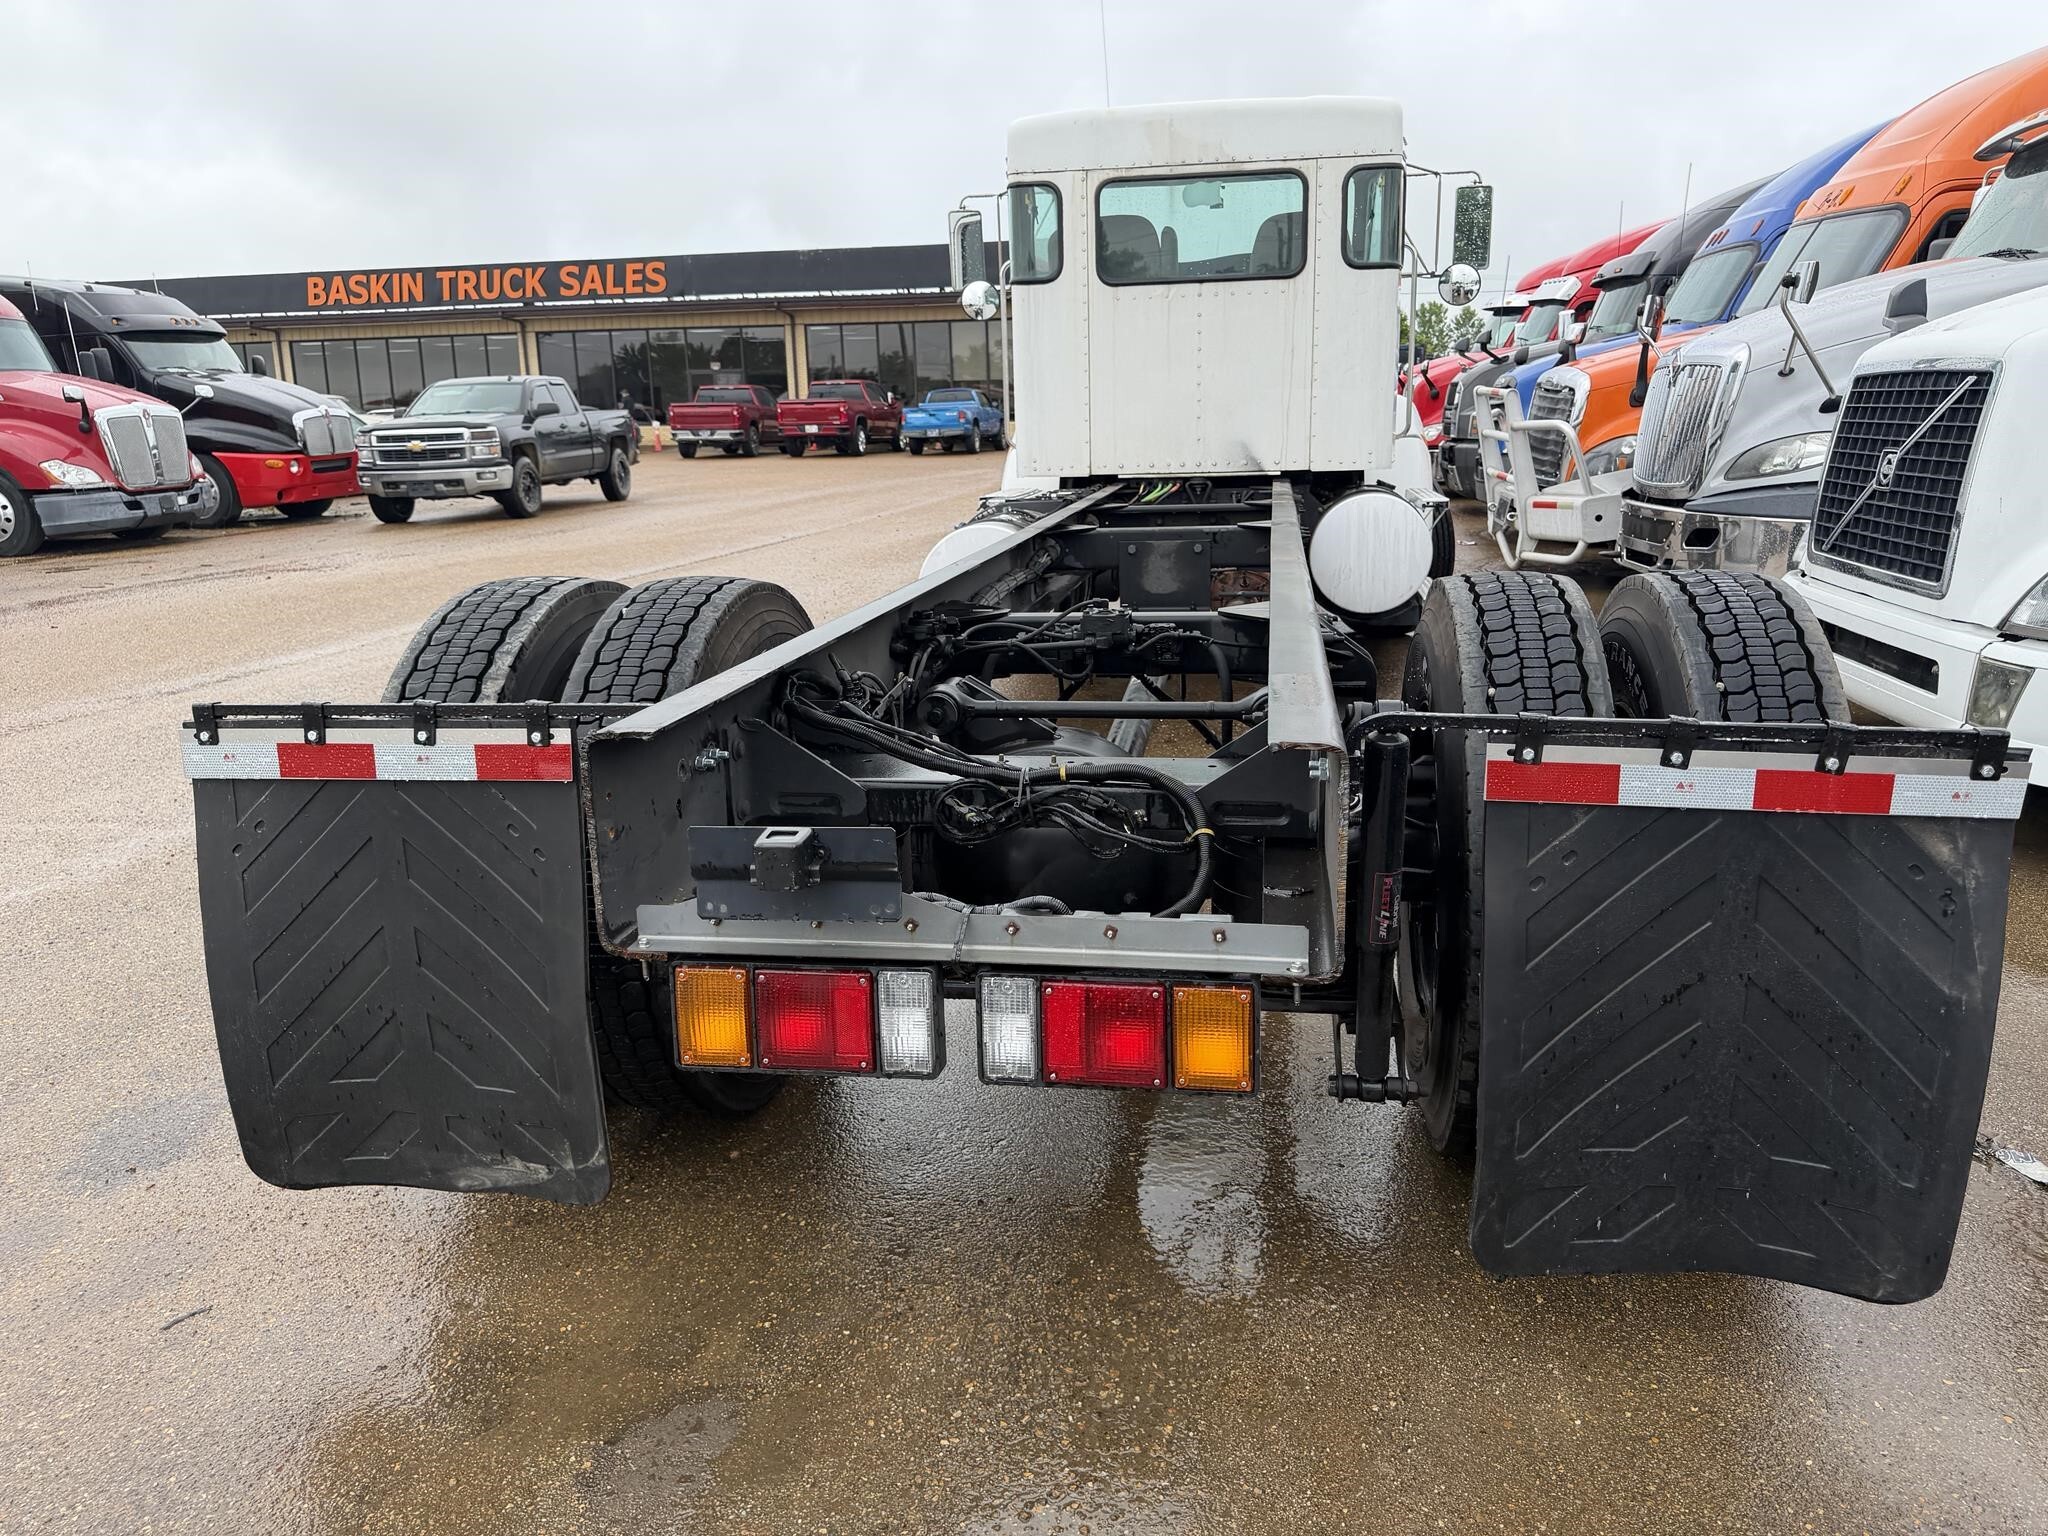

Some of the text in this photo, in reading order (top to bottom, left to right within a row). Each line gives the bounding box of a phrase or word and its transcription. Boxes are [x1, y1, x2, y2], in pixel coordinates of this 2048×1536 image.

[306, 261, 668, 306] BASKIN TRUCK SALES
[1605, 641, 1649, 716] RANCE
